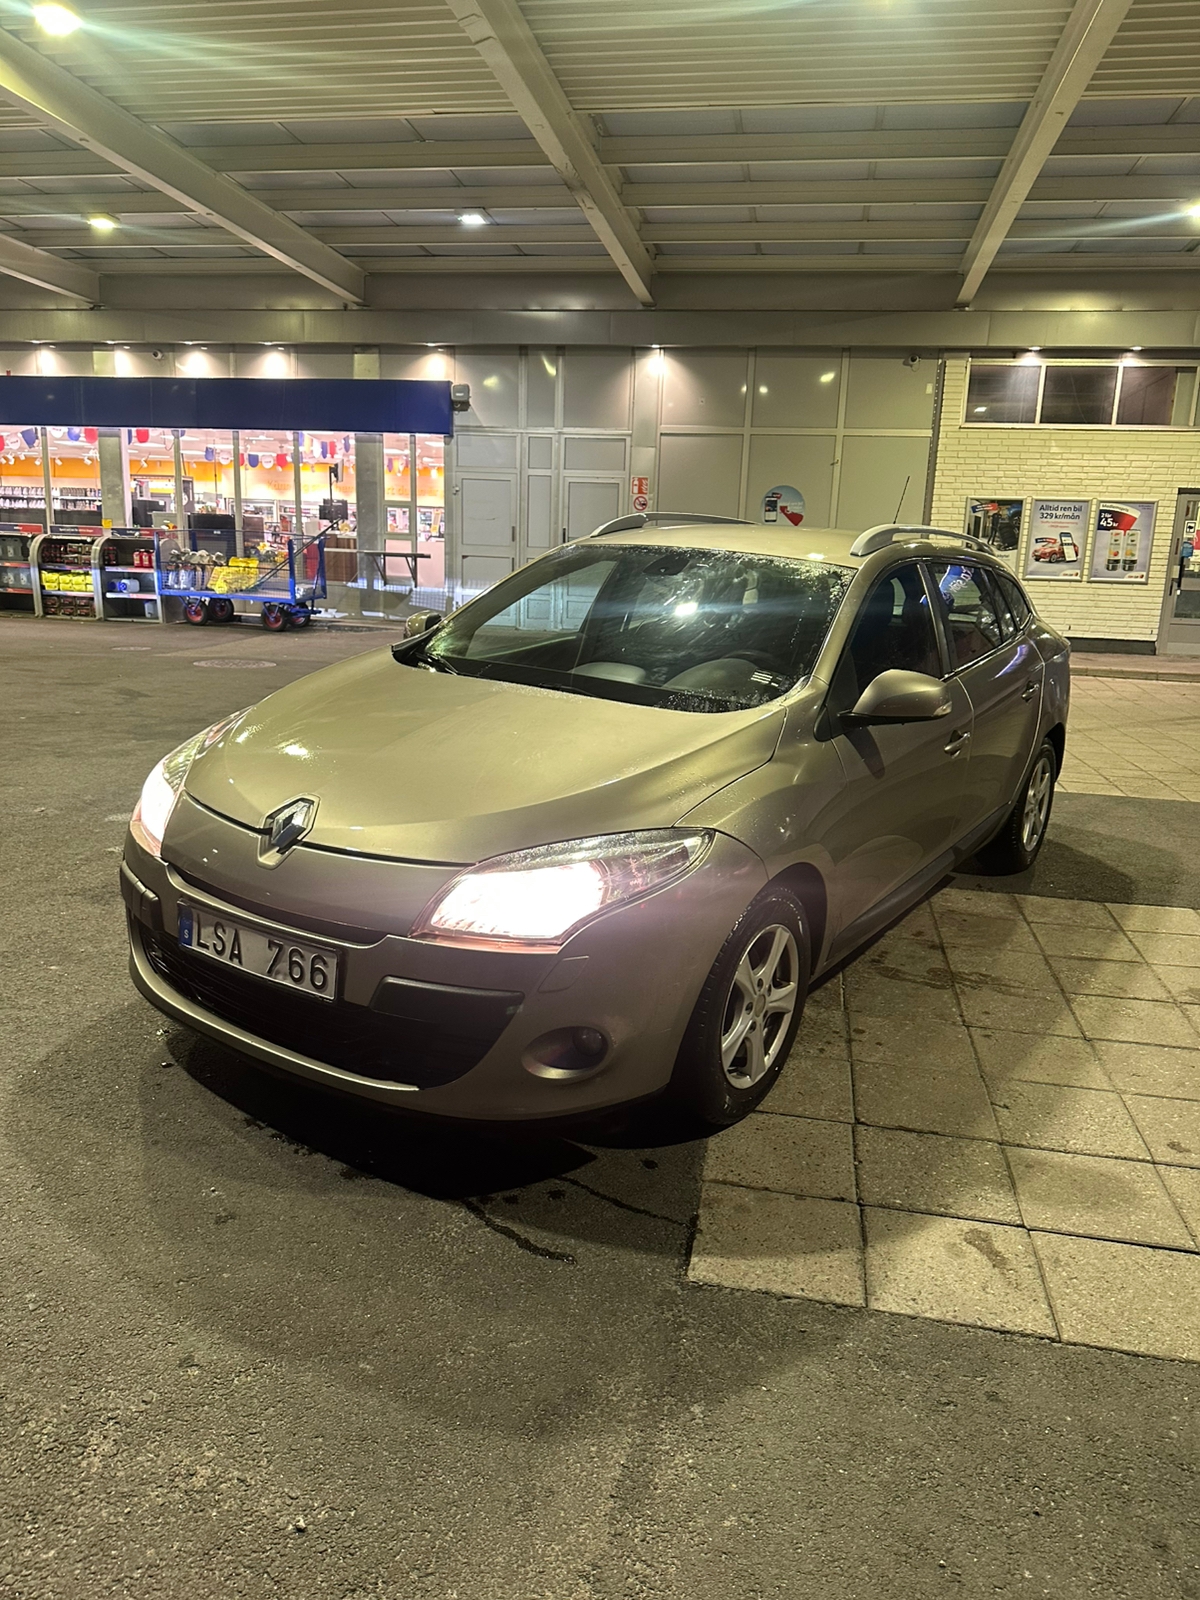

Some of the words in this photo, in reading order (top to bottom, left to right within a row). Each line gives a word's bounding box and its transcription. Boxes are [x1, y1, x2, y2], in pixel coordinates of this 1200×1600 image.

[1039, 504, 1059, 512] Alltid
[1073, 504, 1083, 512] bil
[1039, 512, 1054, 520] 329
[1054, 512, 1081, 520] kr/mån
[1099, 517, 1113, 527] 45
[184, 930, 190, 939] S
[196, 912, 244, 967] LSA
[266, 938, 328, 990] 766
